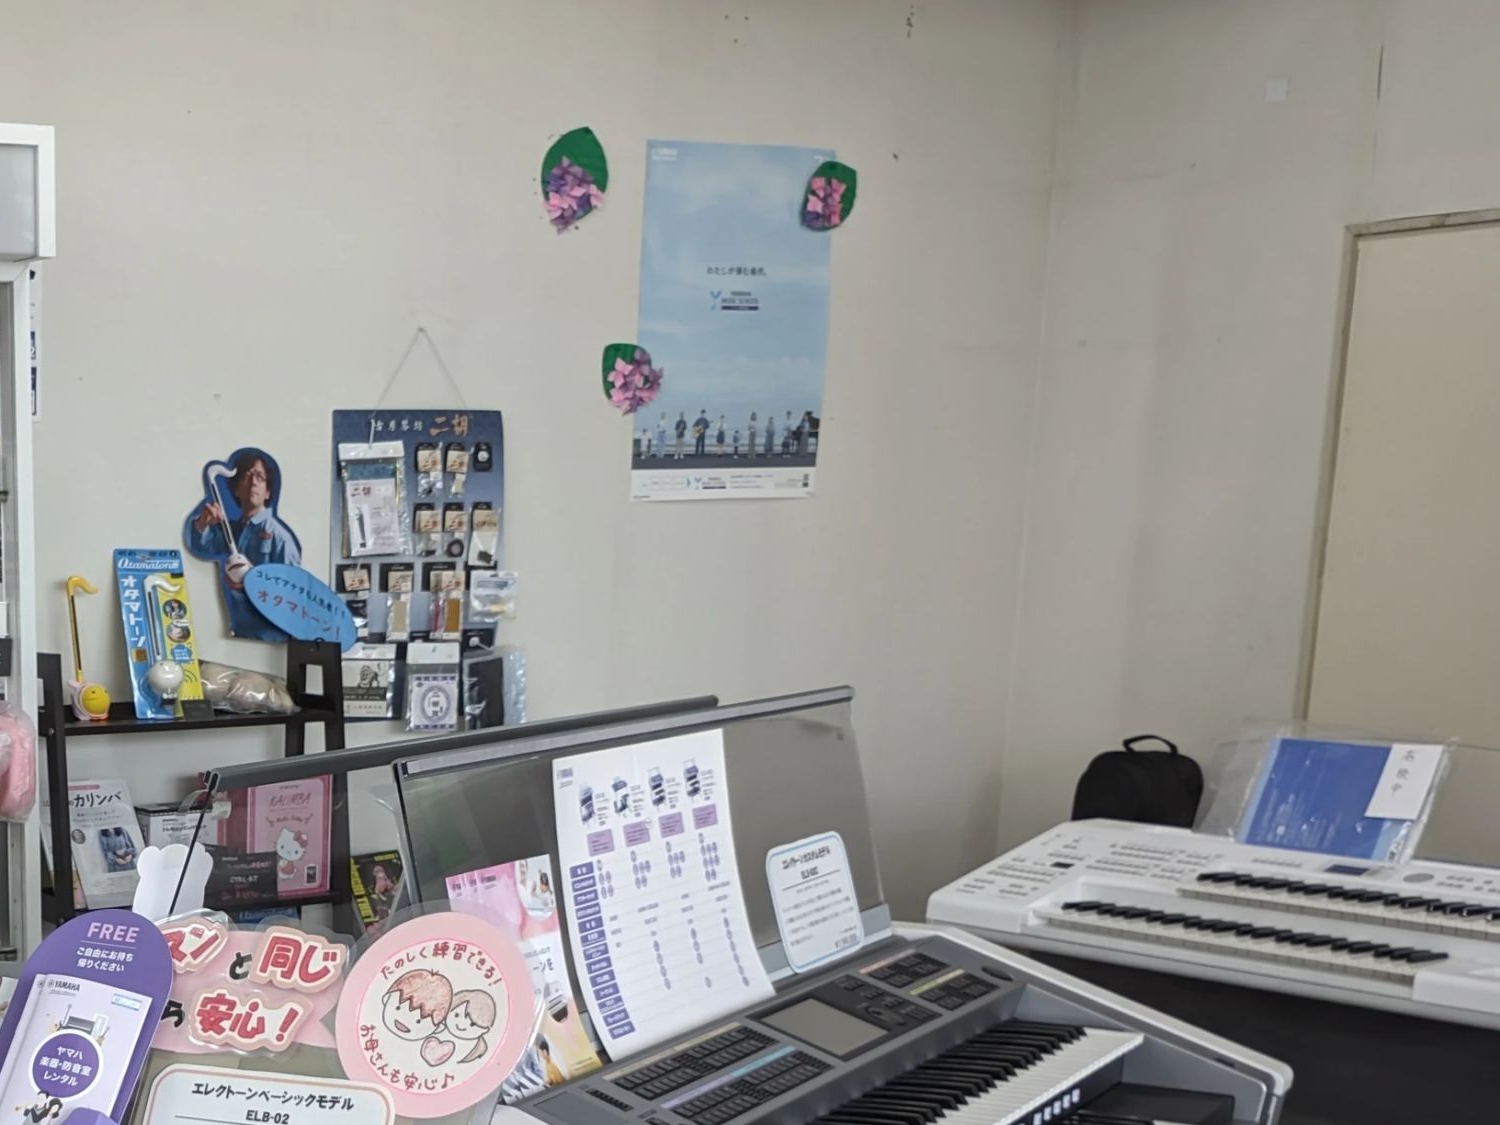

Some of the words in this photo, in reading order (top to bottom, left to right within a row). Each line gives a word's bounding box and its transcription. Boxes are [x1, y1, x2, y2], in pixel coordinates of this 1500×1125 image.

[429, 414, 468, 437] 二胡
[121, 575, 147, 648] オタマトーン
[74, 791, 122, 808] カリンバ
[87, 922, 140, 943] FREE
[76, 946, 134, 963] ご自由にお持ち
[77, 958, 125, 972] 帰りください
[55, 980, 80, 992] YAMAHA
[57, 1046, 83, 1060] ヤマハ
[43, 1070, 79, 1087] レンタル
[192, 1083, 354, 1111] エレクトーンベーシックモデル
[246, 1110, 290, 1125] ELB-02
